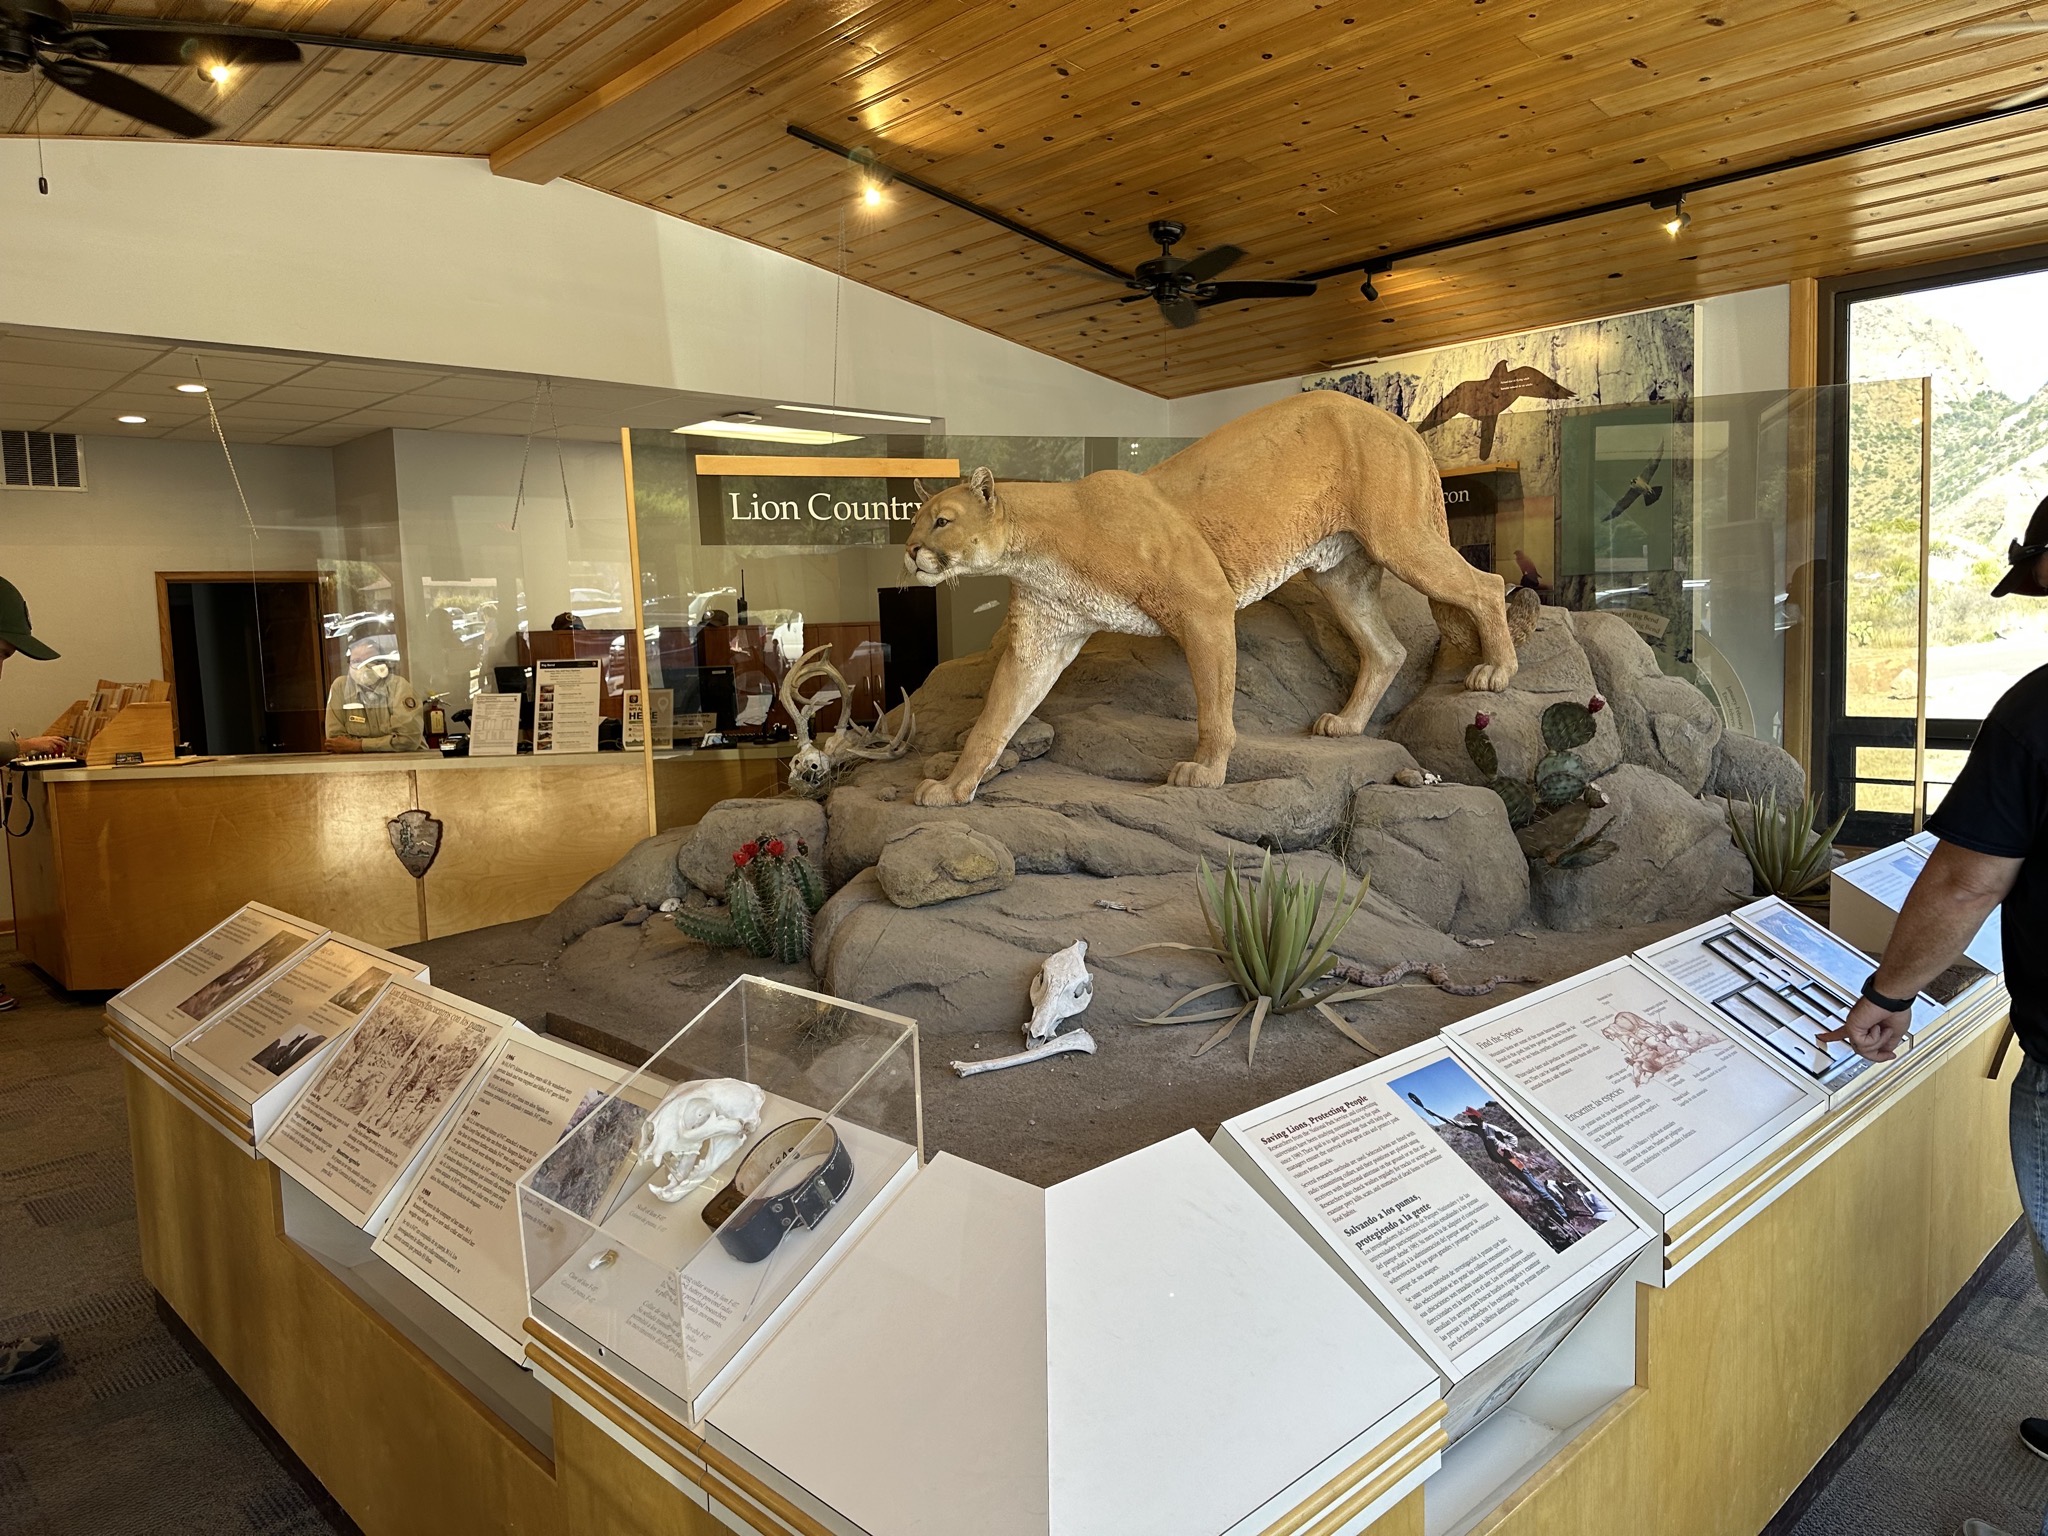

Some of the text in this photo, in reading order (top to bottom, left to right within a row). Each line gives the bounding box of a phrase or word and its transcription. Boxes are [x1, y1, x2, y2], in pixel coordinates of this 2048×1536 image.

[728, 492, 800, 520] Lion
[1444, 489, 1470, 504] con
[1632, 612, 1643, 620] Big
[1644, 616, 1660, 624] Bend
[1635, 622, 1660, 634] Big Bend
[629, 712, 658, 720] HEE
[388, 986, 403, 997] Lion
[449, 1013, 462, 1022] con
[459, 1016, 472, 1026] los
[465, 1020, 488, 1036] pumas
[1475, 1025, 1526, 1049] Find the Species
[1563, 1087, 1628, 1121] Encuentre las especies
[1259, 1094, 1370, 1146] Saving Lions, Protecting People
[1266, 1137, 1293, 1151] Researchers
[1308, 1122, 1326, 1132] National
[1332, 1113, 1348, 1122] Service
[1353, 1100, 1378, 1113] cooperating
[1272, 1144, 1298, 1158] universities
[1315, 1128, 1335, 1139] studying
[1332, 1120, 1352, 1131] mountain
[1278, 1155, 1292, 1164] since
[1301, 1146, 1314, 1154] Their
[1312, 1142, 1324, 1150] goal
[1329, 1134, 1340, 1142] gain
[1337, 1125, 1361, 1138] knowledge
[1372, 1114, 1385, 1122] help
[1381, 1110, 1393, 1118] park
[1286, 1160, 1308, 1172] managers
[1305, 1154, 1320, 1162] ensure
[1325, 1142, 1342, 1152] survival
[1351, 1132, 1364, 1141] great
[1376, 1120, 1392, 1130] protect
[1389, 1116, 1401, 1124] park
[1342, 1214, 1378, 1237] Salvando
[1380, 1204, 1396, 1216] los
[1393, 1192, 1422, 1211] pumas,
[1353, 1219, 1401, 1250] protegiendo
[1401, 1211, 1413, 1221] la
[1409, 1201, 1434, 1218] gente
